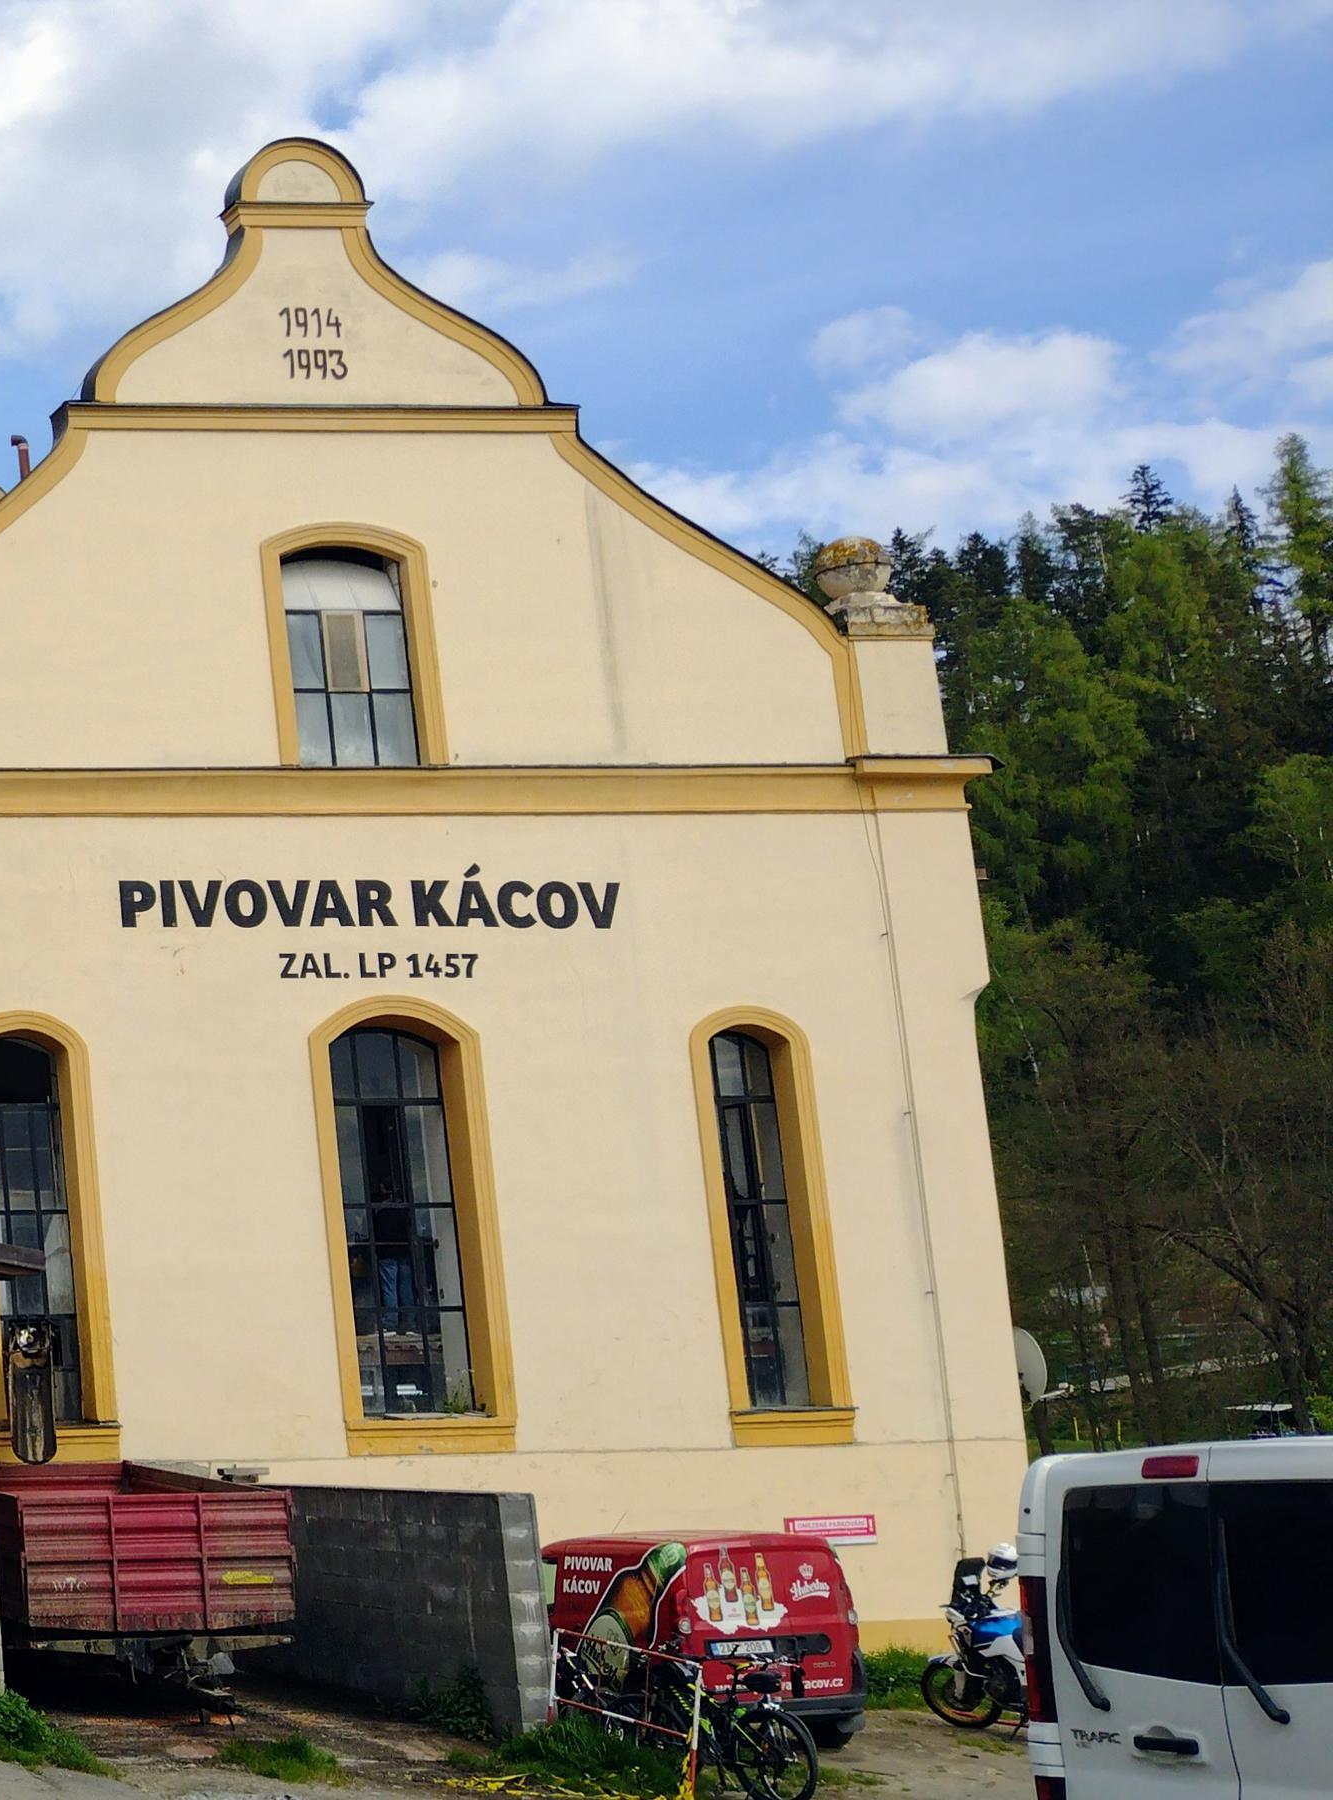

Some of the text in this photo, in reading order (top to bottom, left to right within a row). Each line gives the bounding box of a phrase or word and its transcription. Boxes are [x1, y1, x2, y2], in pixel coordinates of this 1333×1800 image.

[278, 307, 342, 338] 1914
[282, 348, 348, 380] 1993
[118, 863, 620, 929] PIVOVAR KÁCOV
[279, 953, 478, 979] ZAL. LP 1457
[564, 1556, 613, 1571] PIVOVAR
[563, 1575, 601, 1594] KÁCOV
